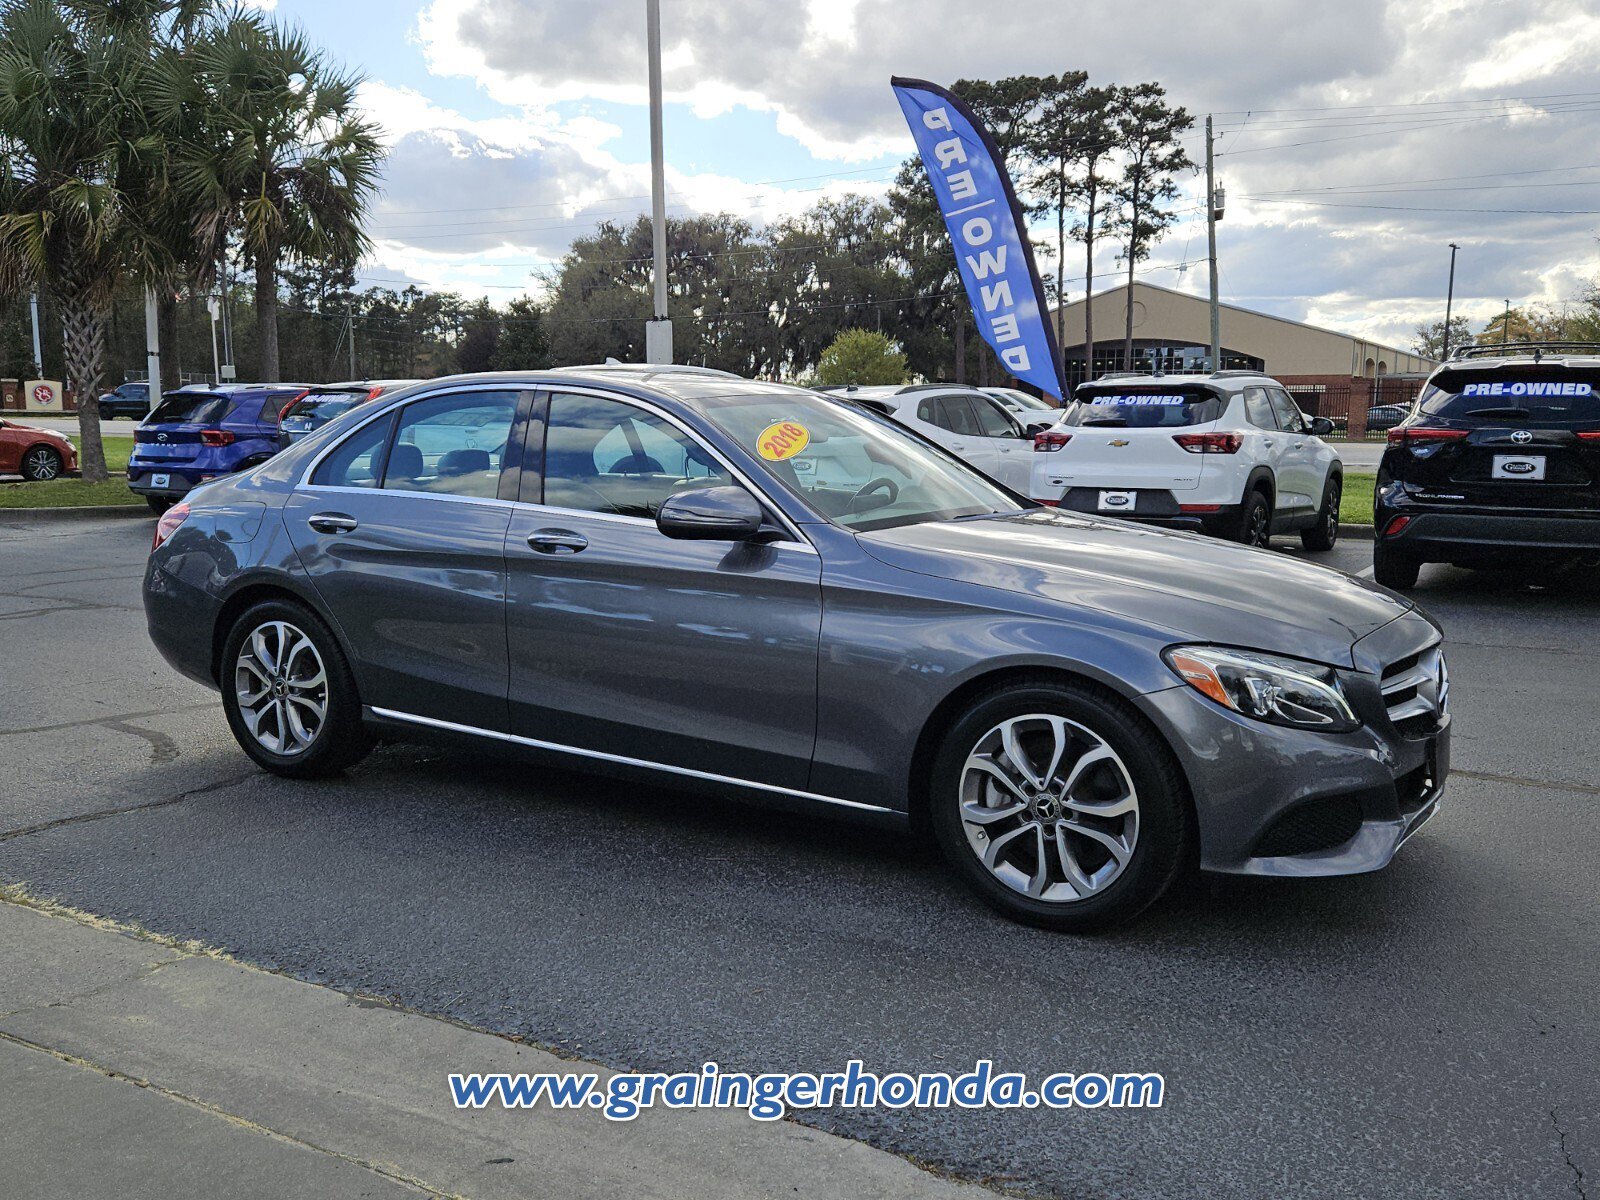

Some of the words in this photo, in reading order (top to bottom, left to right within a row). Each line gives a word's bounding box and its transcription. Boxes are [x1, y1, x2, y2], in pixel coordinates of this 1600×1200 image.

[1463, 382, 1592, 396] PRE-OWNED
[1091, 395, 1184, 405] PRE-OWNED
[763, 423, 804, 458] 2018
